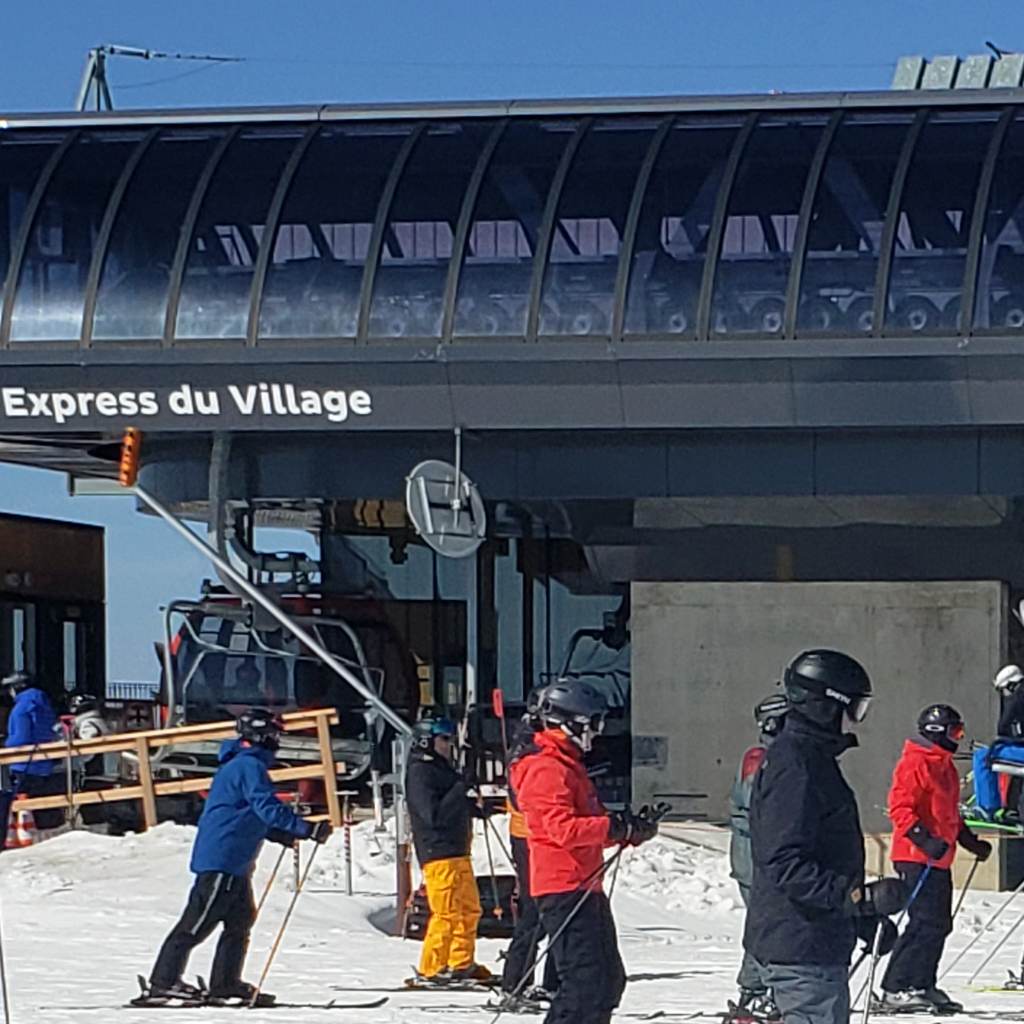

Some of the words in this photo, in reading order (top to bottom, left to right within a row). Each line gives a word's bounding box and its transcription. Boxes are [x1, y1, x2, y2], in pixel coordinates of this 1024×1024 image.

[1, 387, 159, 423] Express
[168, 384, 220, 415] du
[228, 382, 373, 422] Village
